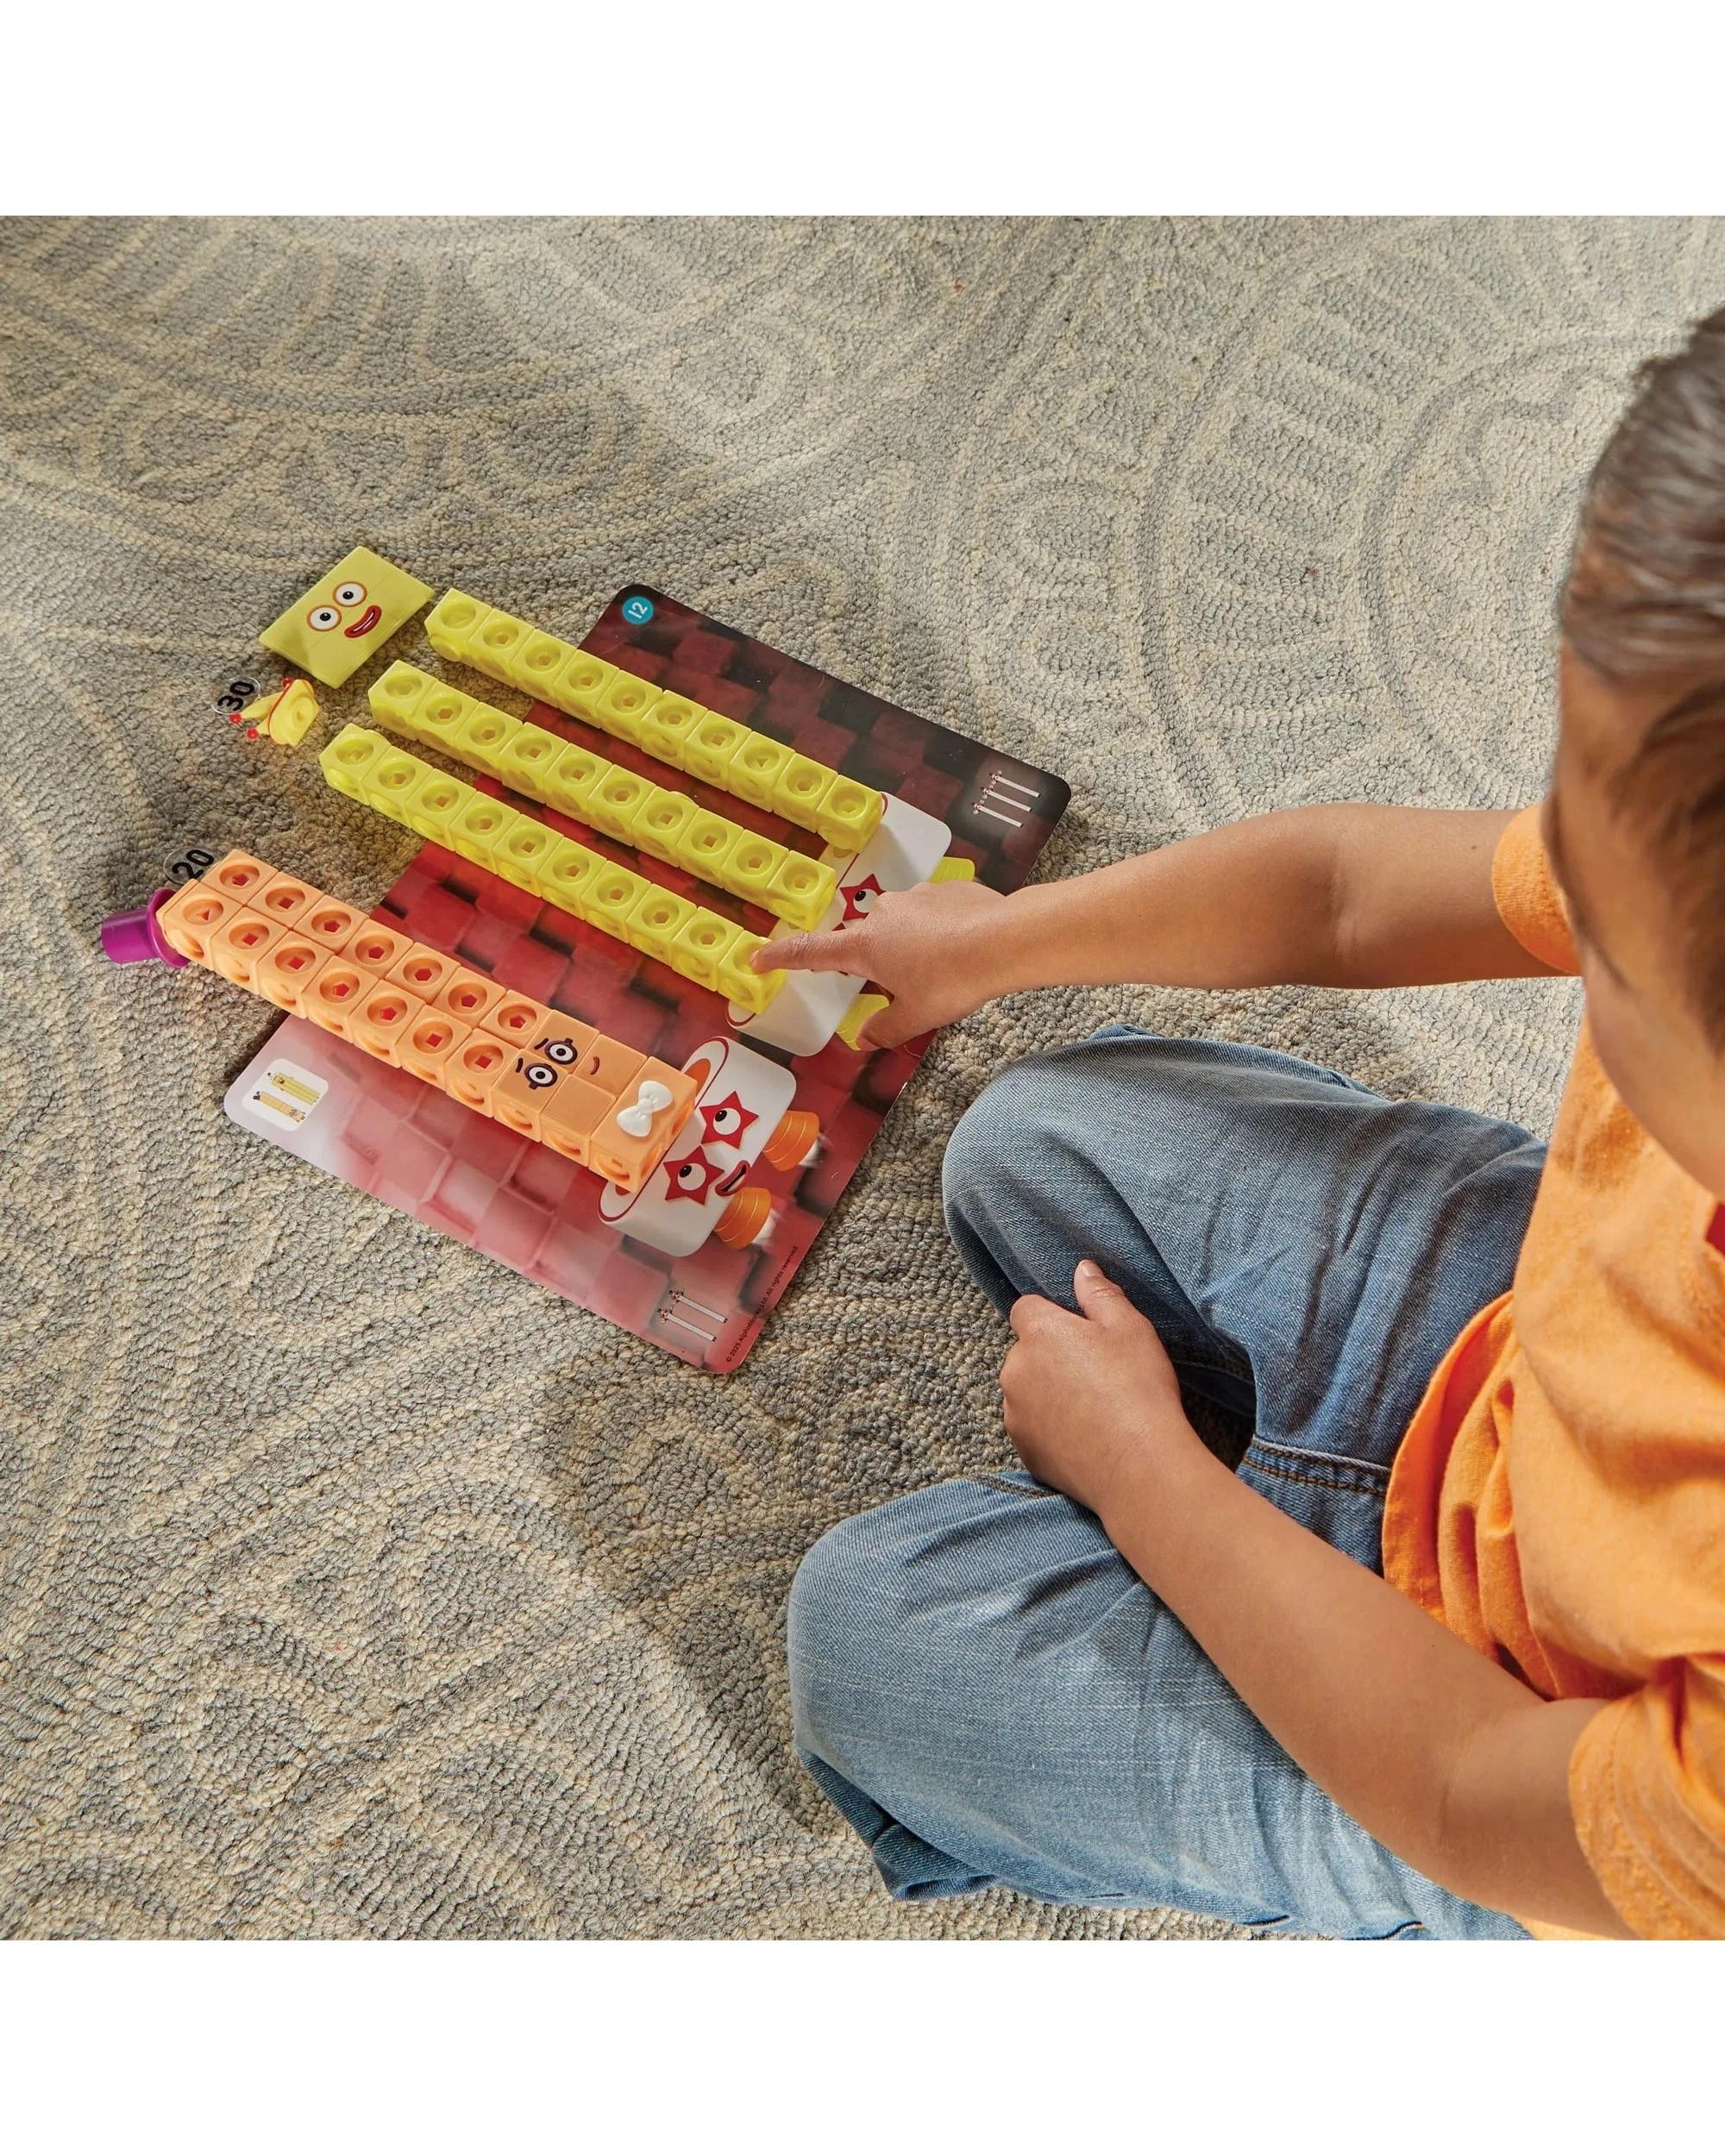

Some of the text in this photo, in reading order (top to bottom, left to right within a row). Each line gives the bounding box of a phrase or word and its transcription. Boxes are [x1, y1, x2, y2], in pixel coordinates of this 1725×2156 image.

[628, 602, 648, 618] 12
[217, 681, 254, 711] 30
[172, 849, 214, 879] 20
[772, 1270, 784, 1287] rights
